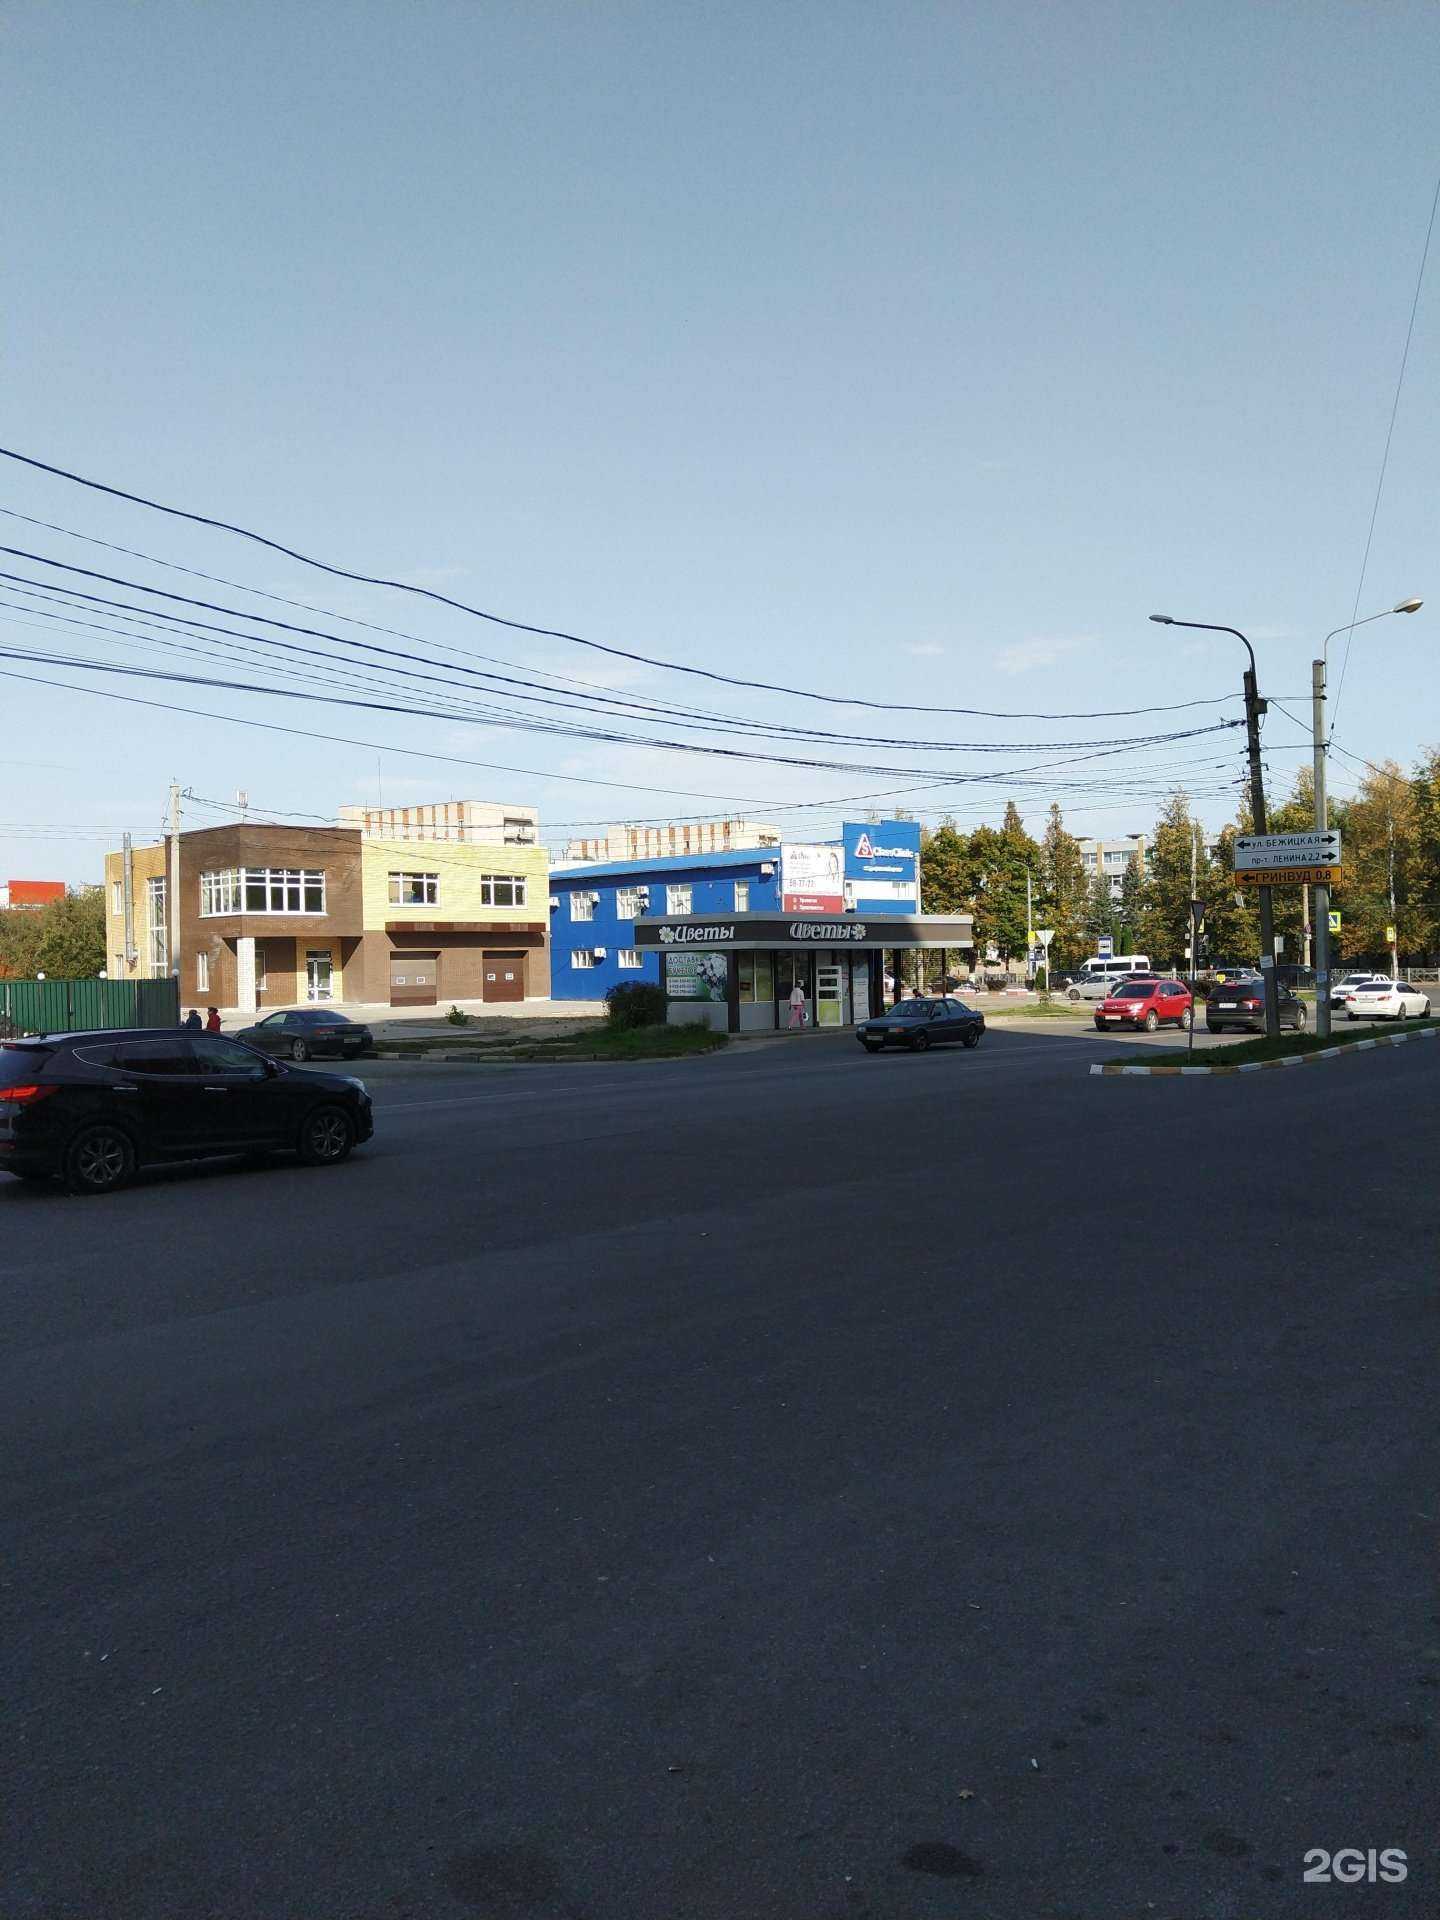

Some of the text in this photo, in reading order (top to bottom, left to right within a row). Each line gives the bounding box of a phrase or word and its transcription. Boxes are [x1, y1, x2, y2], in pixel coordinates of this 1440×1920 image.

[1266, 836, 1320, 848] БЕЖИЦКАЯ
[1272, 854, 1307, 864] ЛЕНИНА
[1255, 871, 1311, 882] ГРИНВУД
[674, 926, 735, 944] Цветы
[790, 922, 852, 940] Цветы
